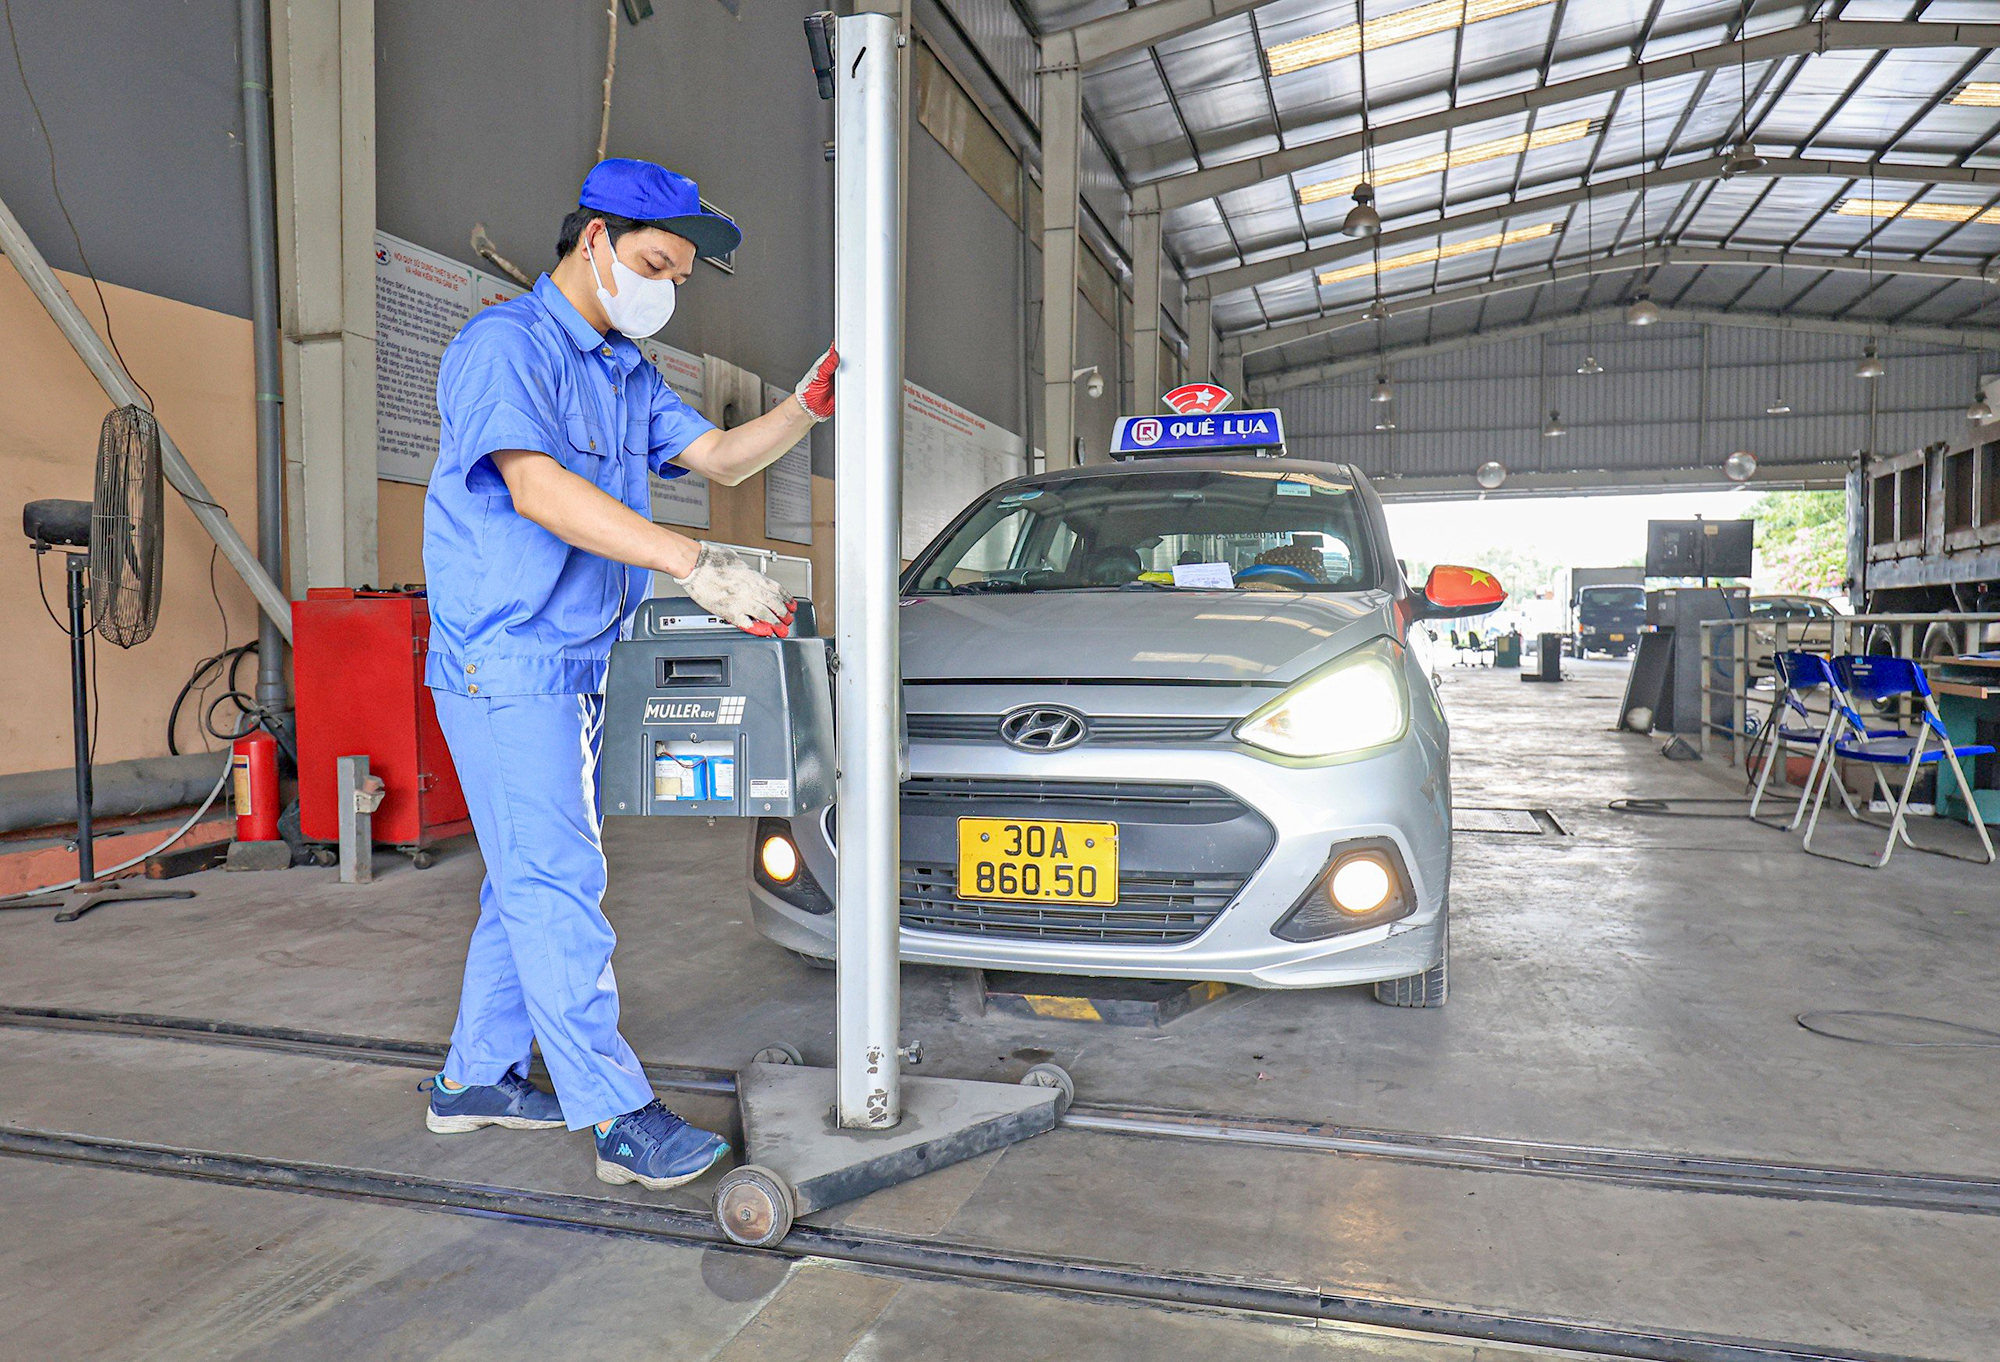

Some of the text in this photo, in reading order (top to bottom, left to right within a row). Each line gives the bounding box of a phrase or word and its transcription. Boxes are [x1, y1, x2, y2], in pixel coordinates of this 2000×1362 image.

[1169, 417, 1215, 440] QUÊ
[1223, 418, 1269, 439] LỤA
[646, 704, 715, 718] MULLER BEM
[1003, 824, 1069, 858] 30A
[976, 861, 1097, 898] 860.50
